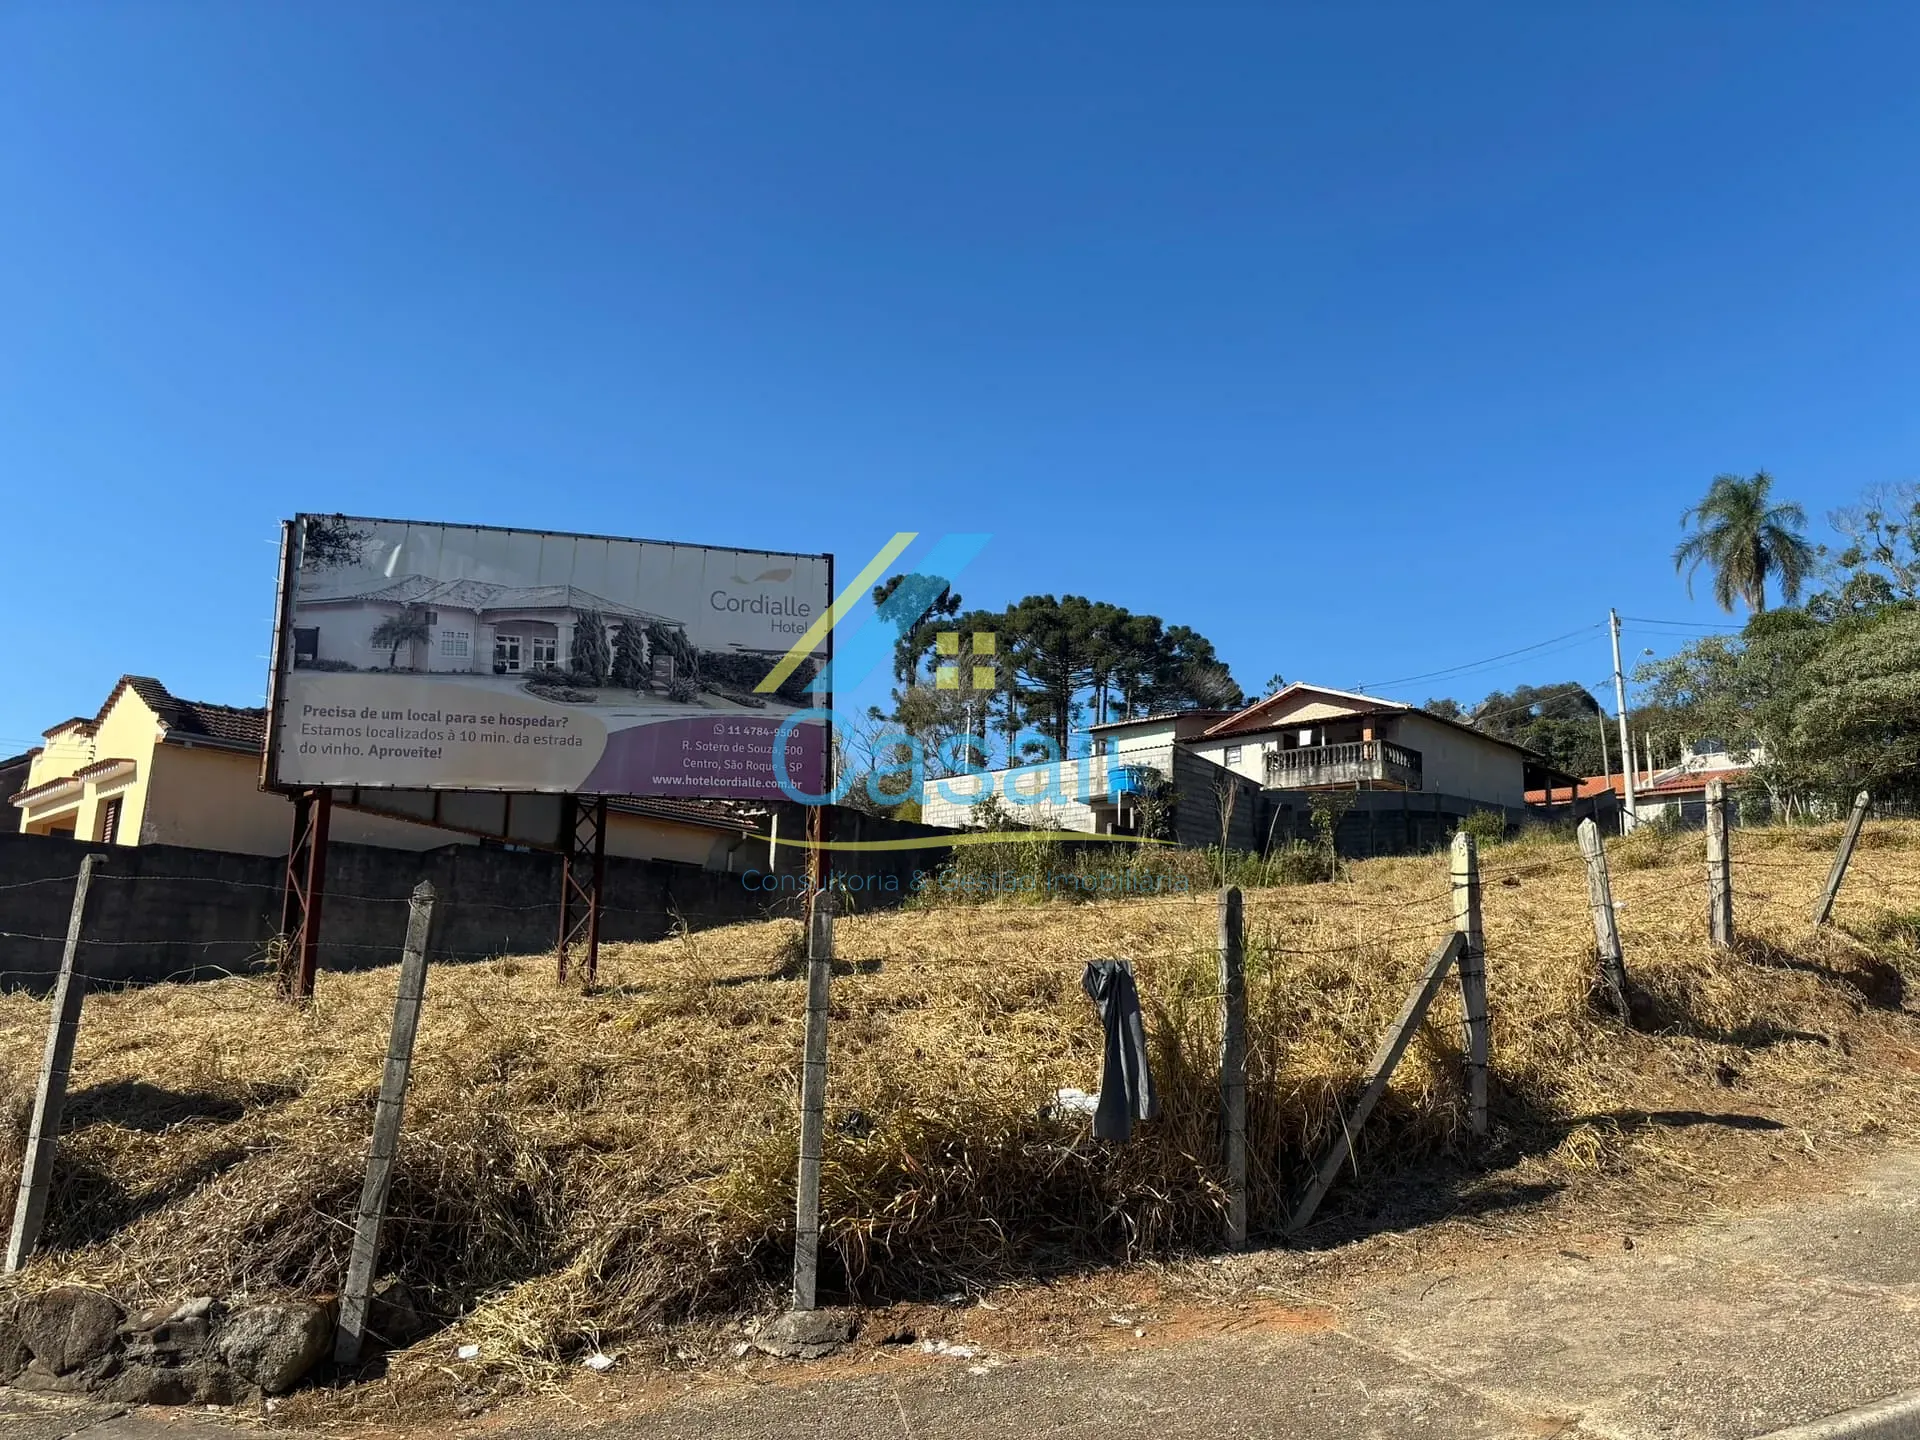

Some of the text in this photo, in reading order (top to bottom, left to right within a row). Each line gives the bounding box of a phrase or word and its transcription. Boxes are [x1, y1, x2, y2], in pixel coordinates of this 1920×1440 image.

[710, 590, 811, 617] Cordialle
[771, 619, 808, 634] Hotel
[303, 704, 569, 729] Precisa de um local para se hospedar?
[301, 723, 583, 747] Estamos localizados à 10 min. da estrada
[727, 726, 800, 738] 11 4784-9500
[299, 741, 442, 760] do vinho. Aproveite!
[682, 740, 803, 756] R. Sotero de Souza, 500
[683, 758, 721, 771] Centro,
[724, 759, 743, 770] São
[746, 761, 777, 773] Roque
[789, 762, 802, 773] SP
[652, 774, 802, 790] www.hotelcordialle.com.br
